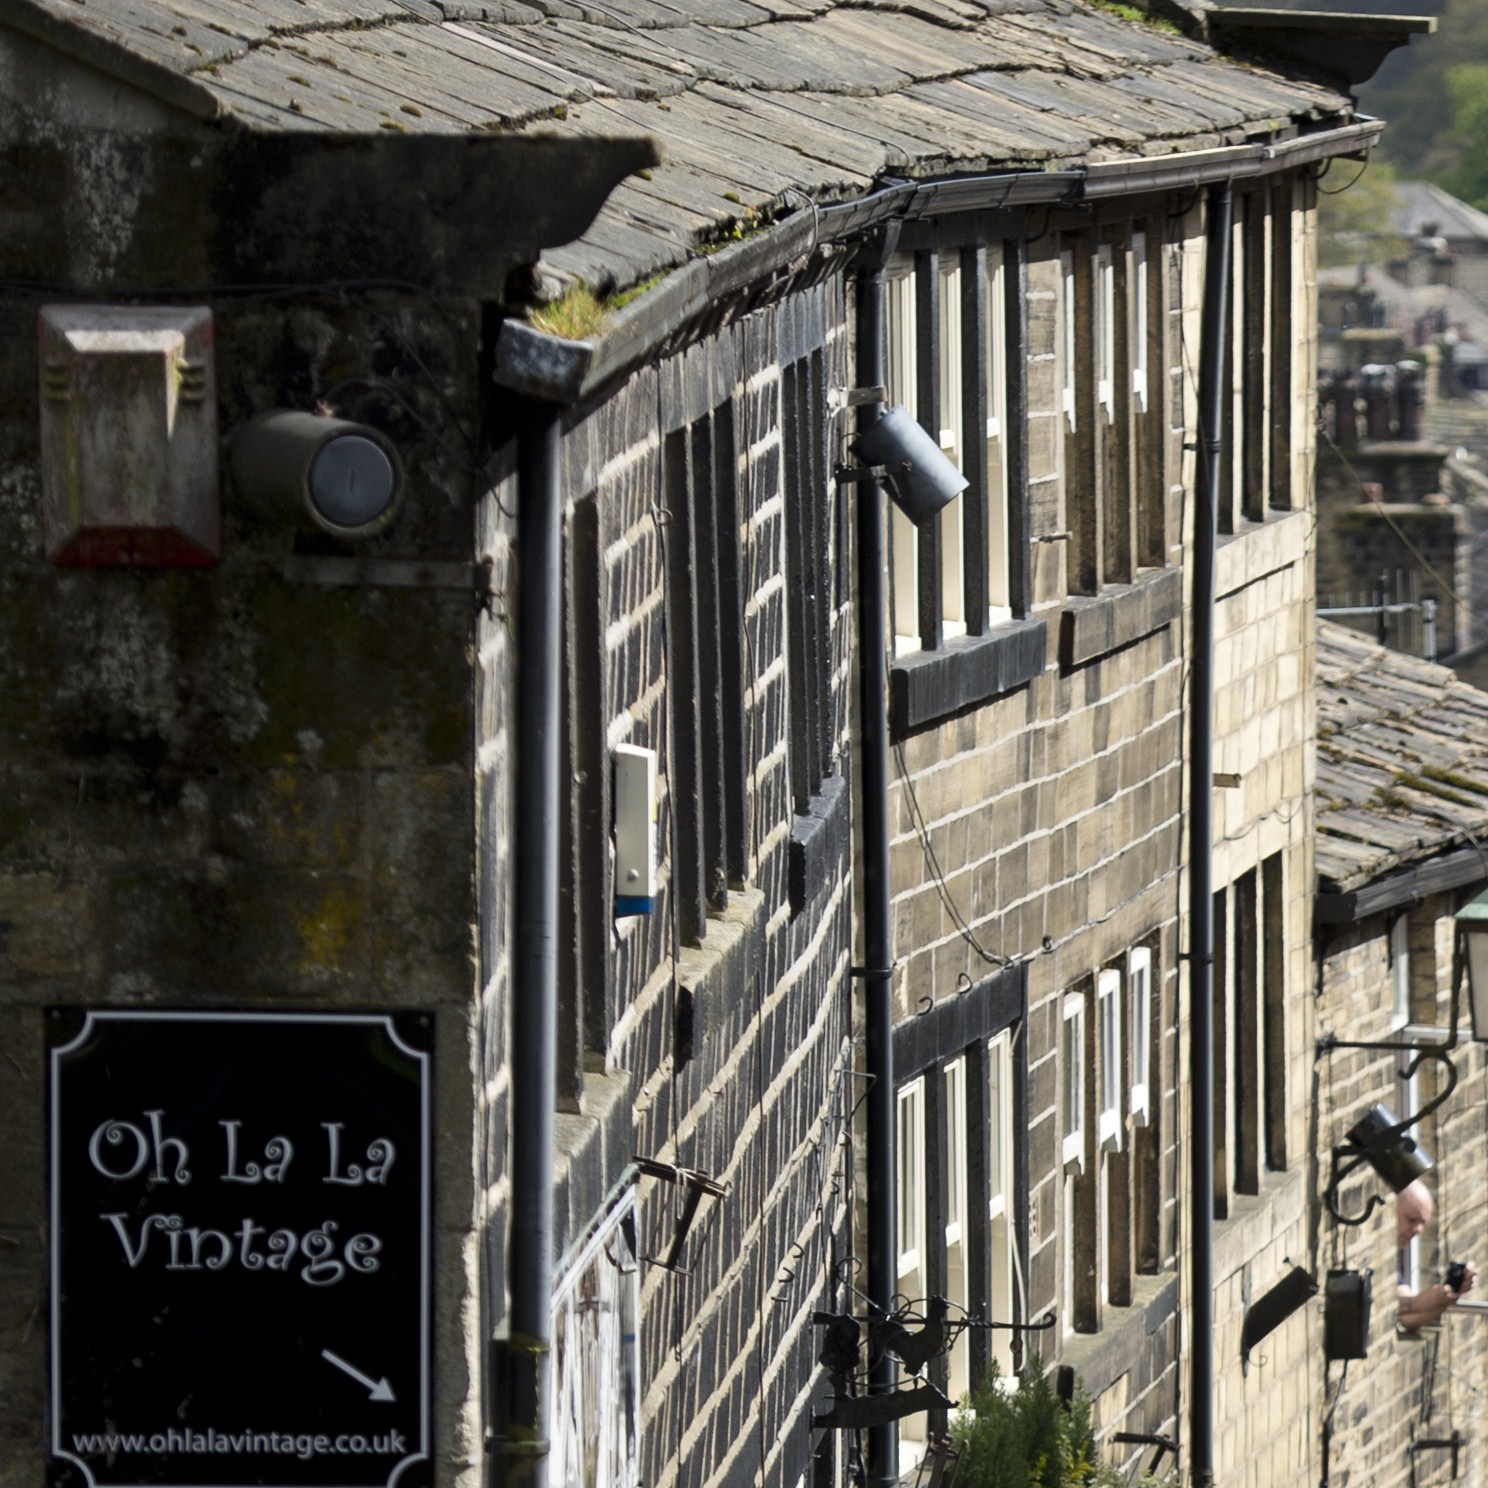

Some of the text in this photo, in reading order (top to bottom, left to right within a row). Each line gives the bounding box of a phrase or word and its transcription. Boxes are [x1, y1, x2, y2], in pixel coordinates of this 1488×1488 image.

[89, 1109, 396, 1186] Oh La La
[100, 1213, 382, 1286] Vintage
[73, 1428, 406, 1459] www.ohlalavintage.co.uk
